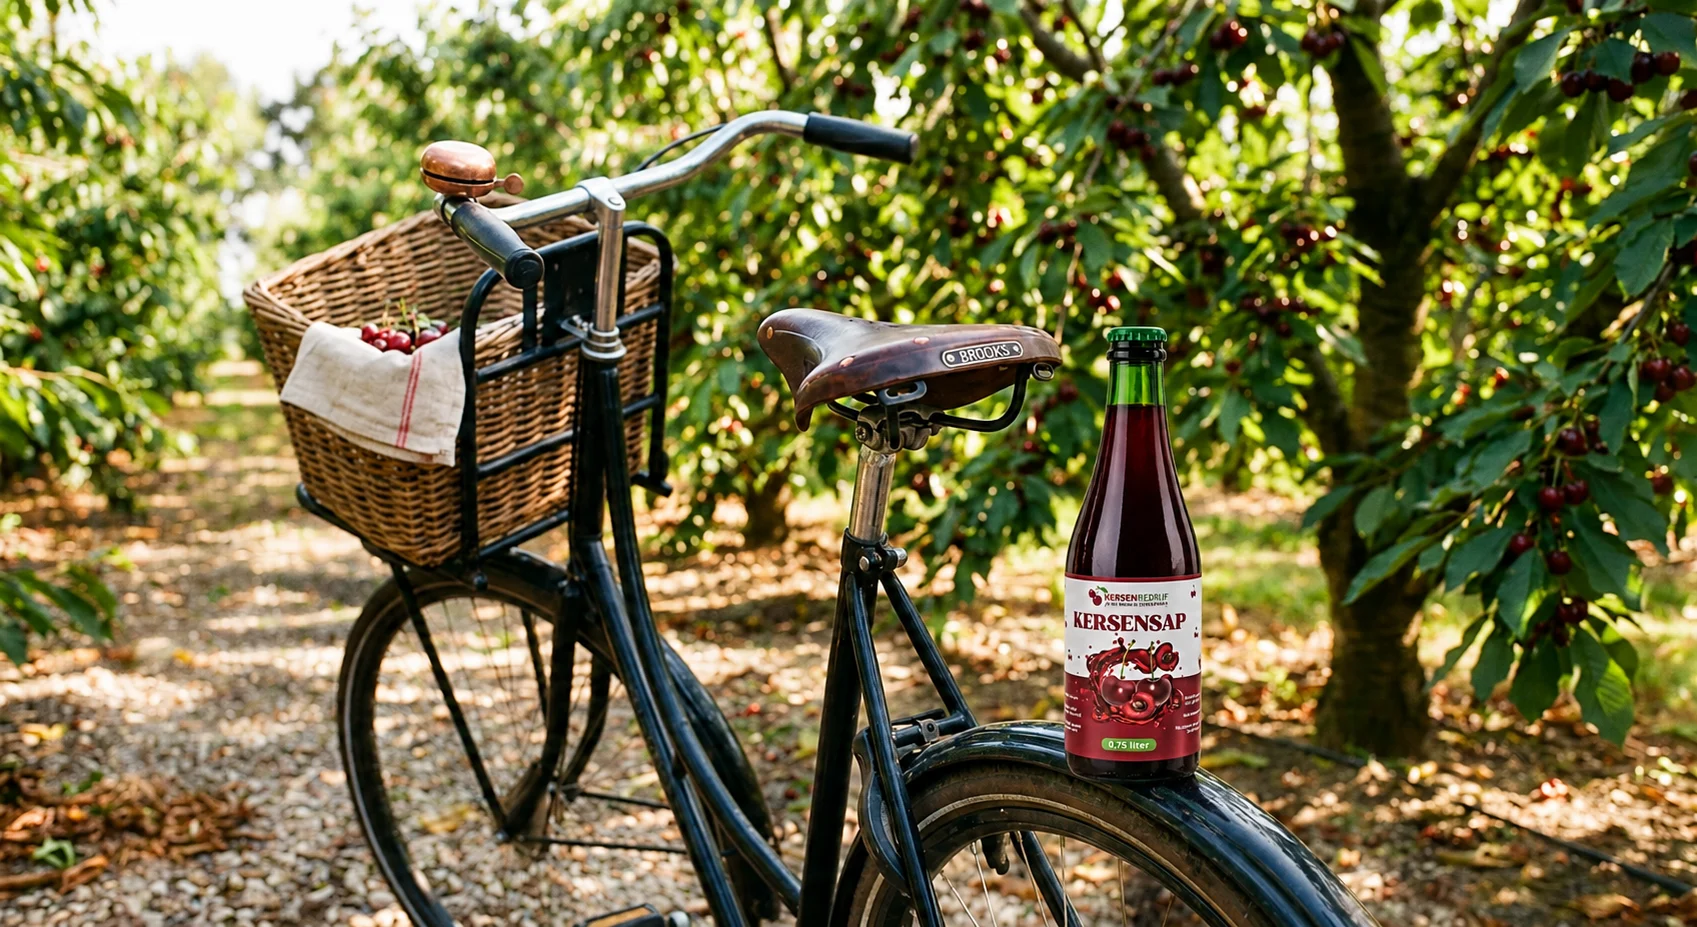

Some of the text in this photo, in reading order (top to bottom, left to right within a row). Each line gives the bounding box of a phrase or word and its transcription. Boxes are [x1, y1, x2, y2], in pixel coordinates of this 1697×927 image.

[959, 344, 1011, 363] BROOKS
[1073, 611, 1187, 632] KERSENSAP
[1108, 740, 1150, 750] 0,75 liter
